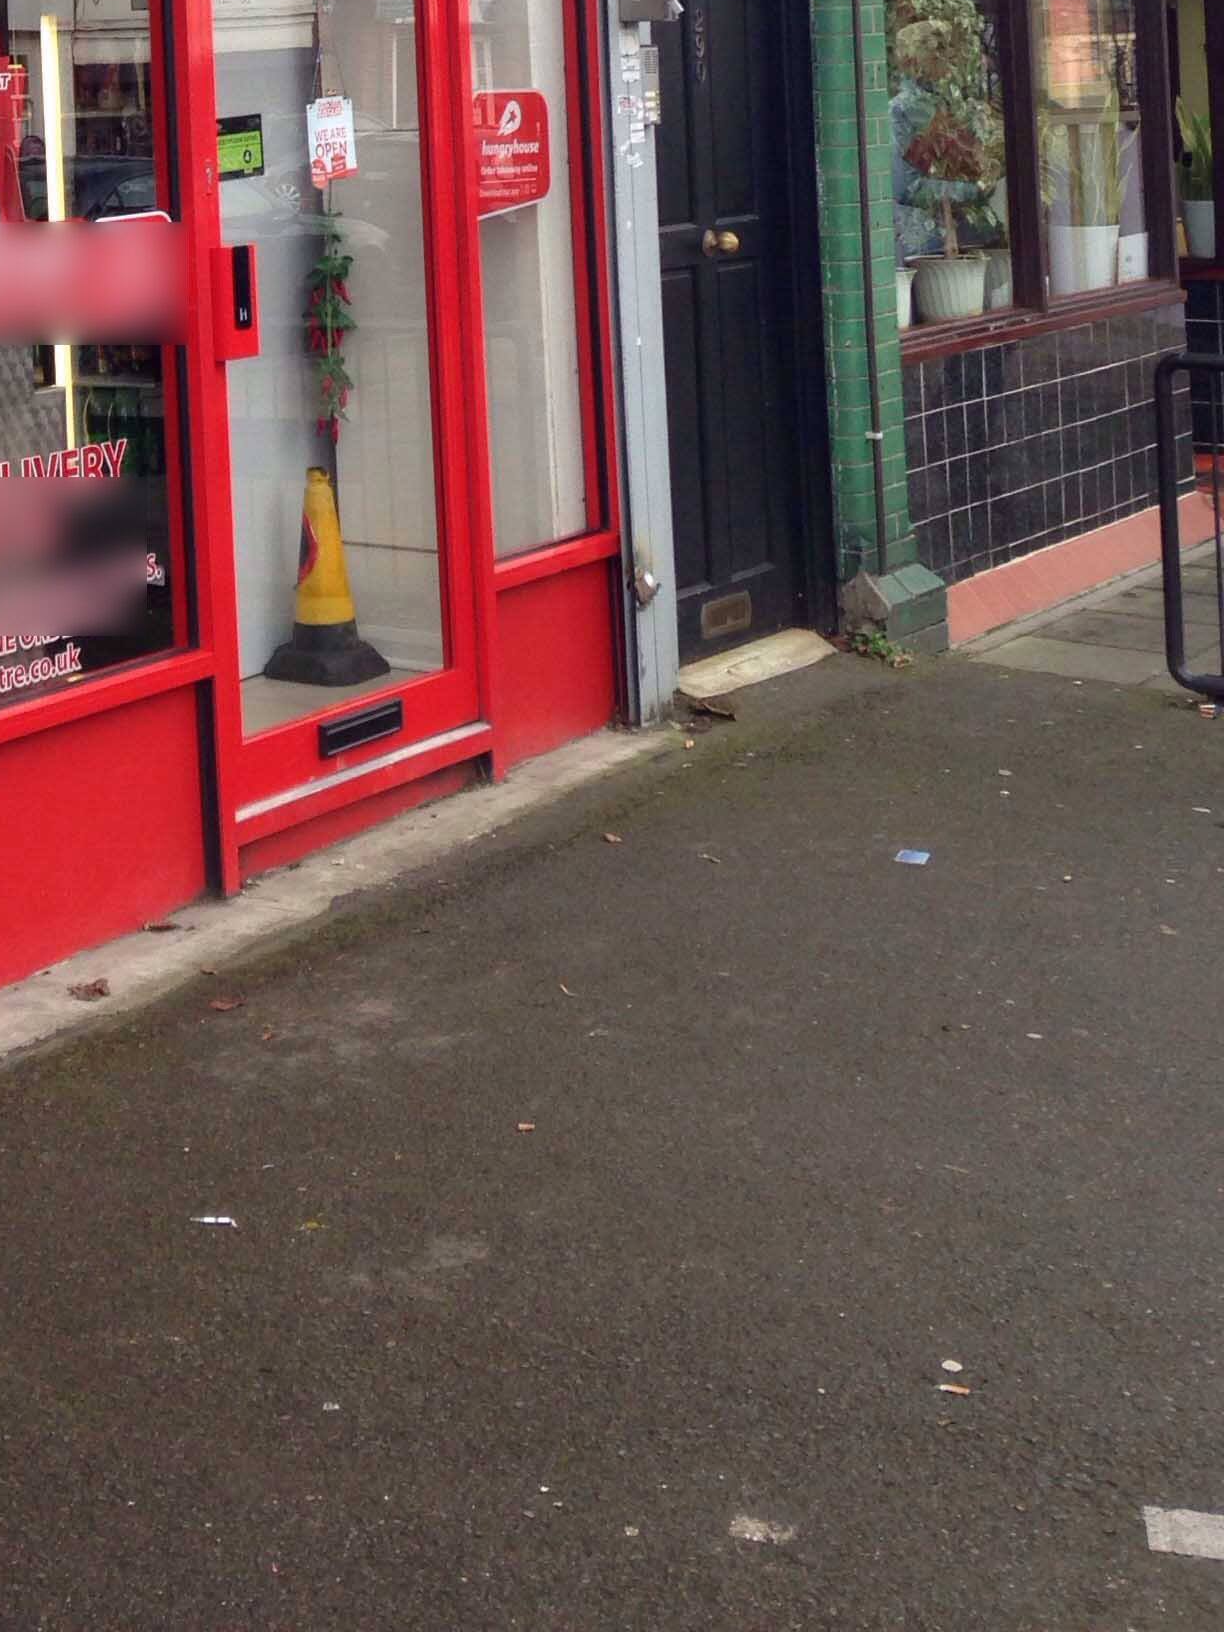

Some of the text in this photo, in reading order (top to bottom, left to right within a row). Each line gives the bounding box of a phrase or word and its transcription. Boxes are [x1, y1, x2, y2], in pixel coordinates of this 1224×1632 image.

[314, 127, 347, 142] WE ARE
[315, 141, 348, 159] OPEN
[481, 137, 540, 159] hungryhouse
